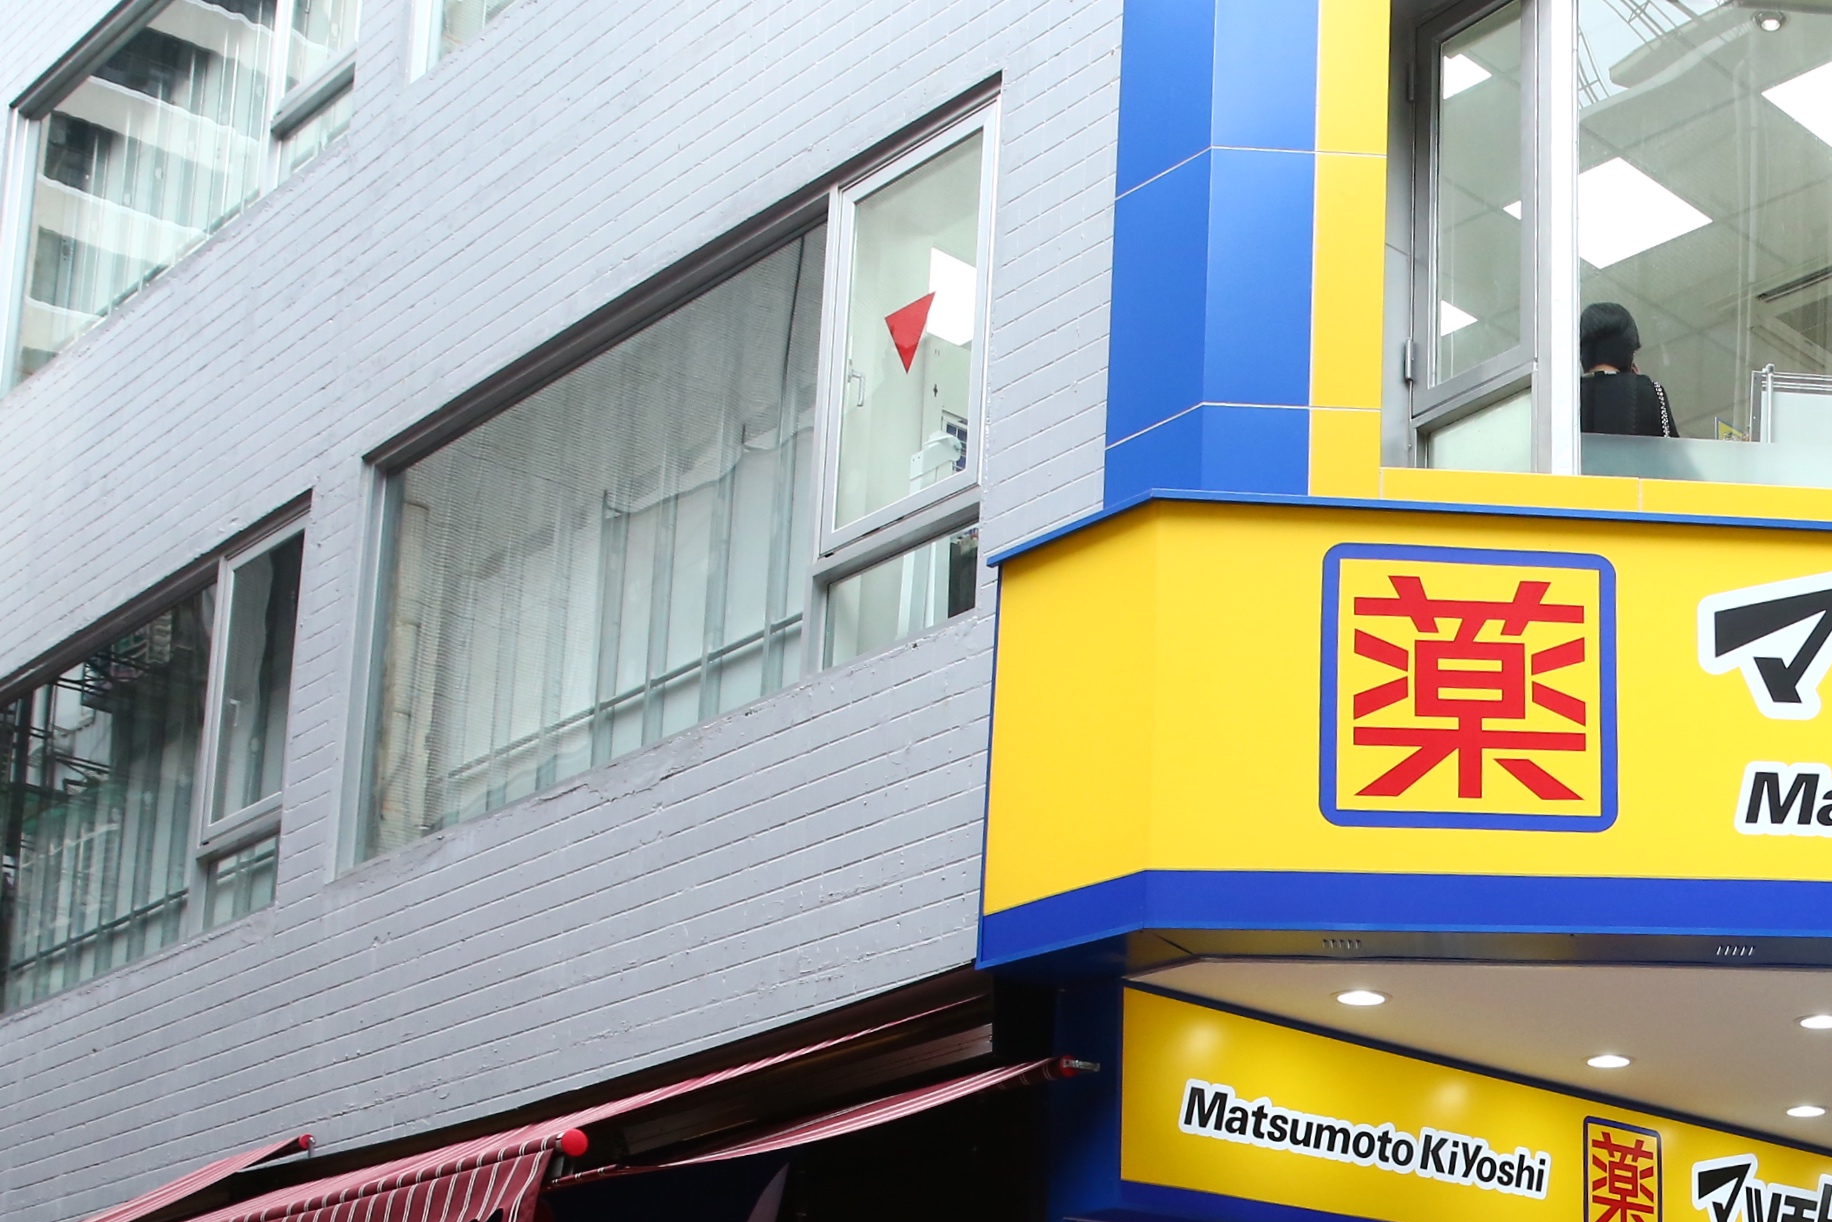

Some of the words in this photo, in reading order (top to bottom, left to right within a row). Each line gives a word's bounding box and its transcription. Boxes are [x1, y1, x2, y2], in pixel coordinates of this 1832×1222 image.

[1353, 575, 1586, 800] 薬
[1183, 1087, 1414, 1167] Matsumoto
[1420, 1132, 1546, 1193] KiYoshi
